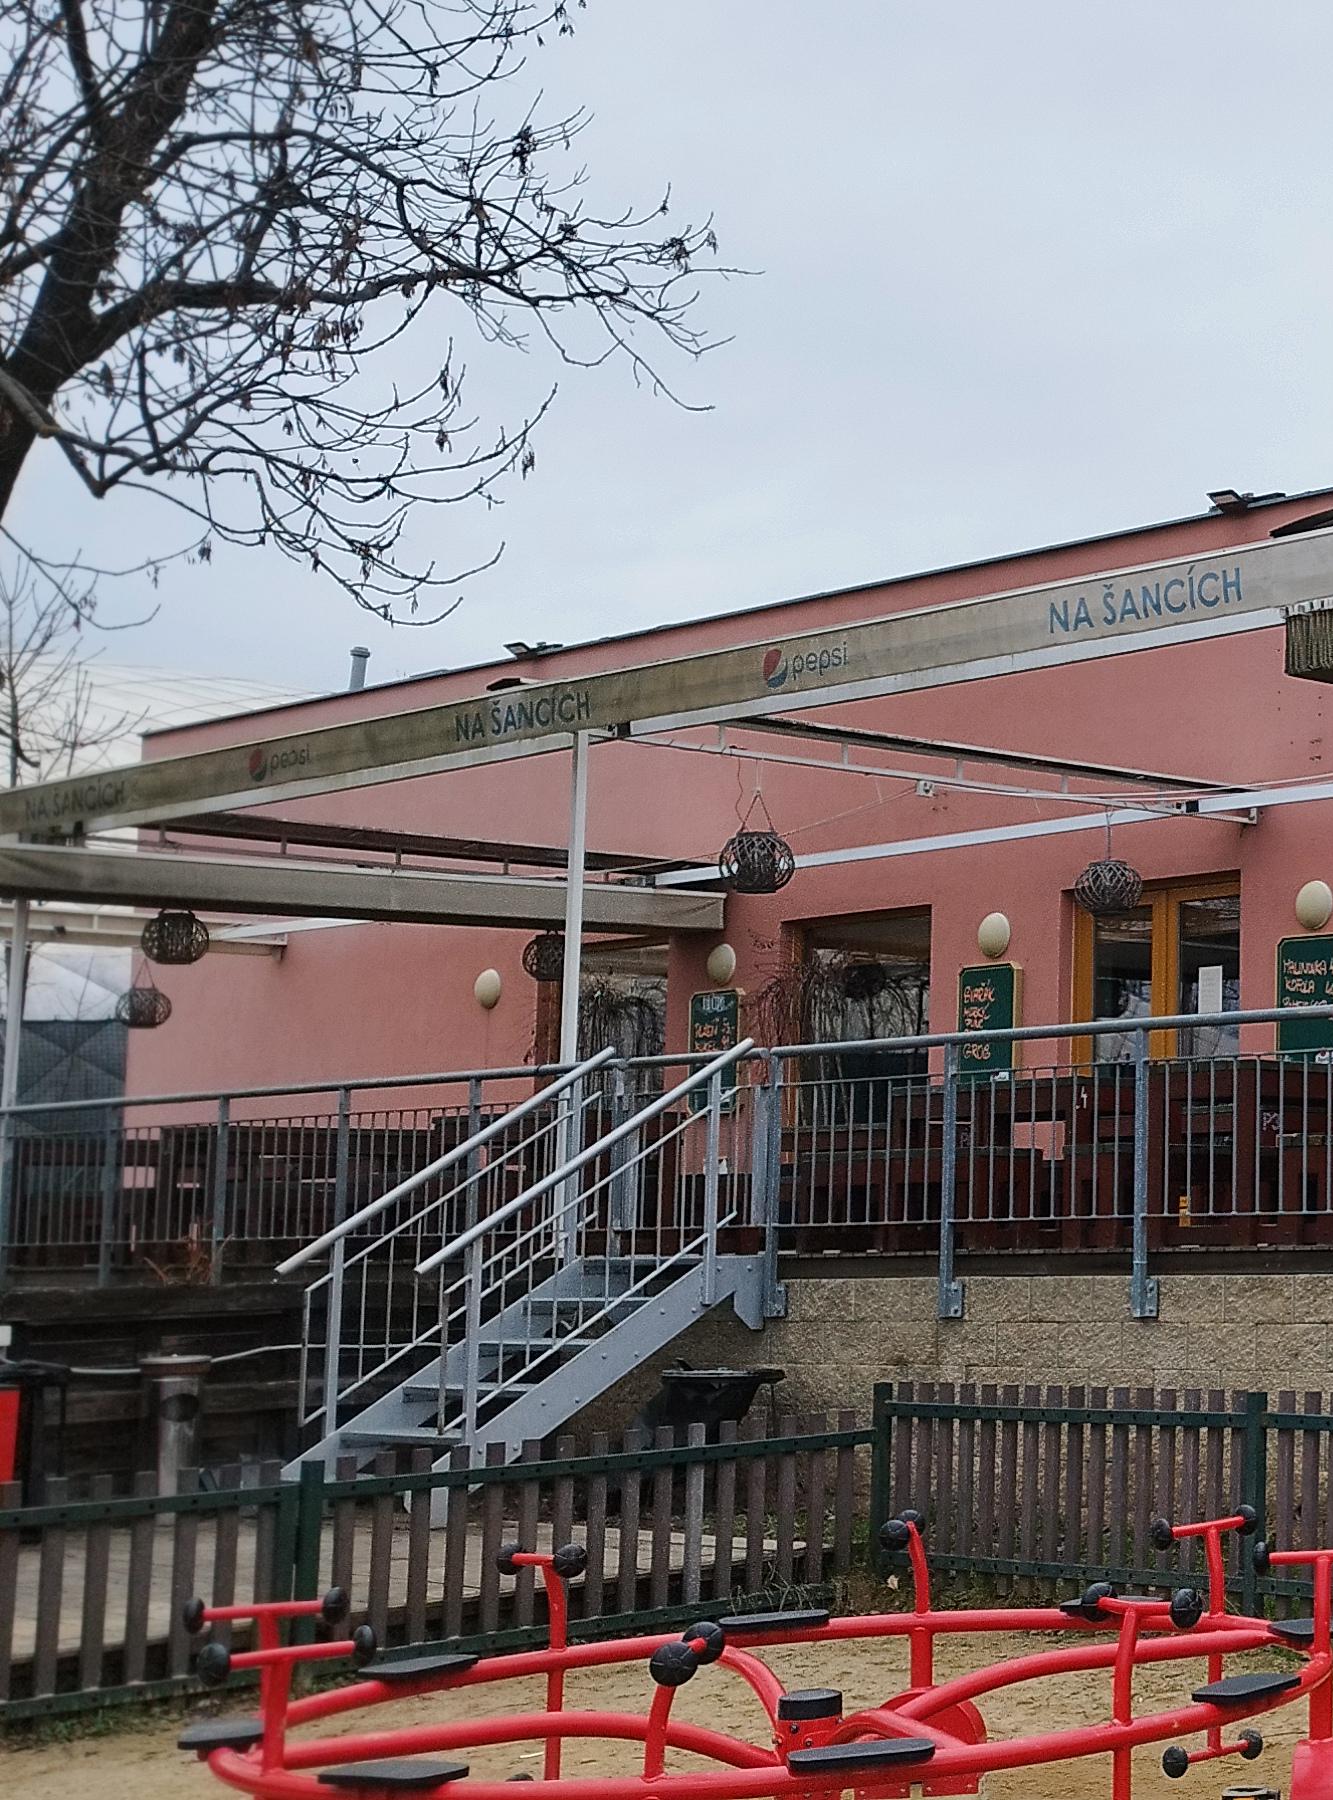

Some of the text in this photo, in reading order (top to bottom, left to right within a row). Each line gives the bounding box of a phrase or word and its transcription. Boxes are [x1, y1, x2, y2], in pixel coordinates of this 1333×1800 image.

[1050, 565, 1242, 633] NA ŠANCÍCH
[793, 641, 848, 680] pepsi
[456, 690, 591, 741] NA ŠANCÍCH
[269, 744, 310, 777] pepsi
[25, 778, 125, 821] NA ŠANCÍCH
